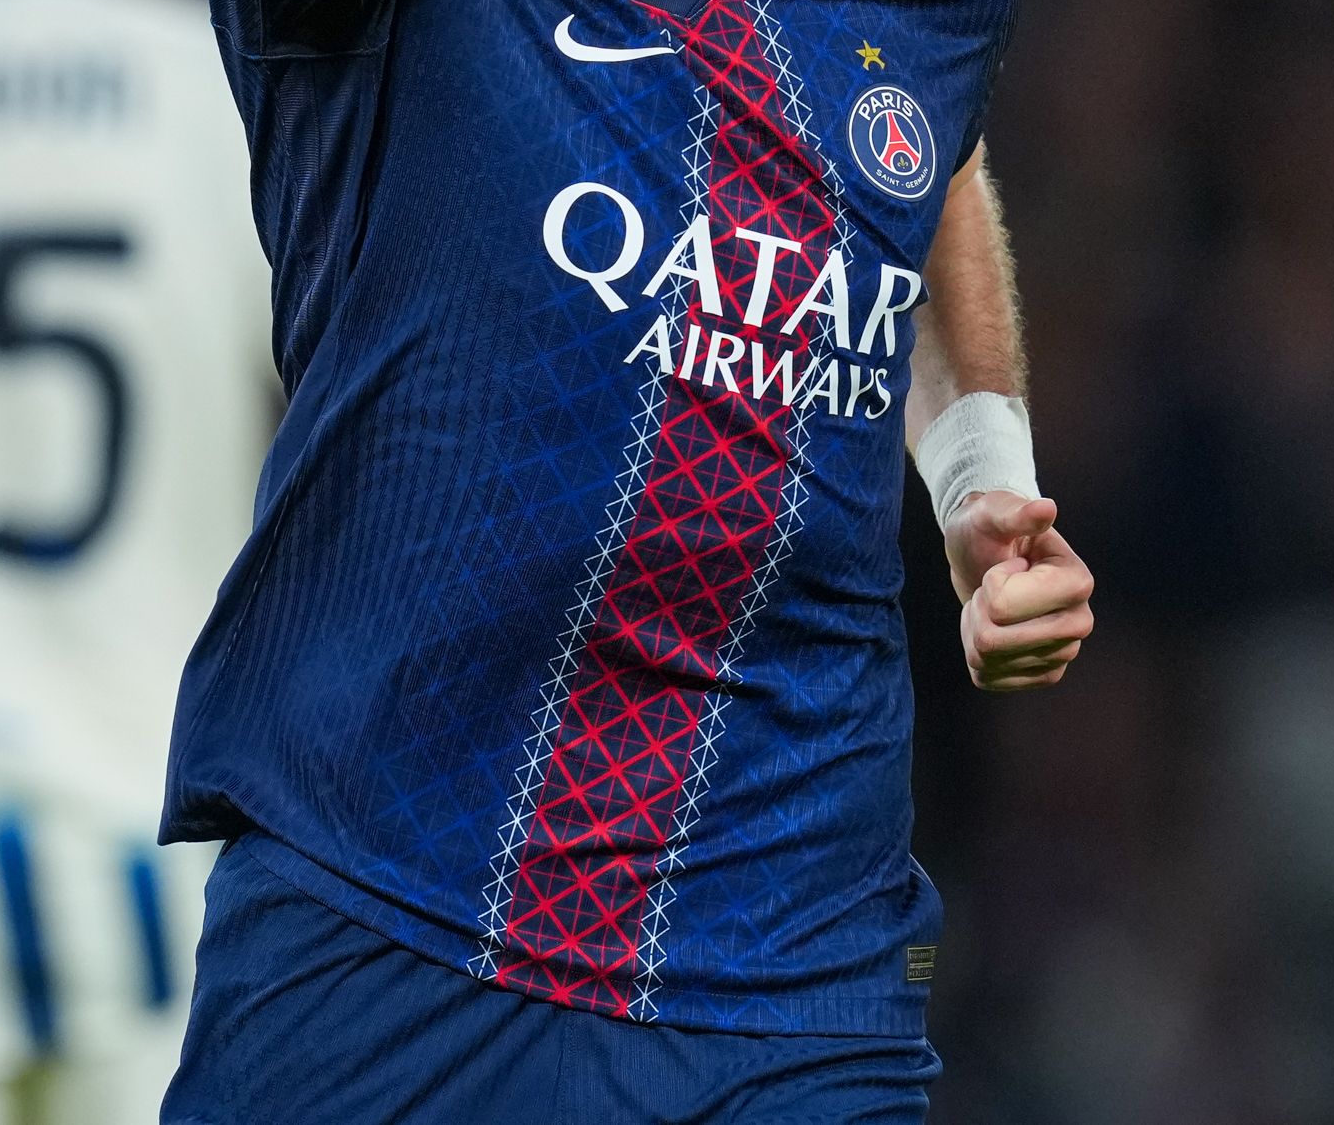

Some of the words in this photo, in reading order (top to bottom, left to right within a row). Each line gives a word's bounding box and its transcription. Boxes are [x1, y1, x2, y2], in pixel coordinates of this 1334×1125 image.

[858, 92, 914, 121] PARIS
[875, 168, 900, 187] SAINT
[905, 167, 929, 189] GERMAIN
[543, 182, 922, 357] QATAR
[623, 314, 892, 420] AIRWAYS
